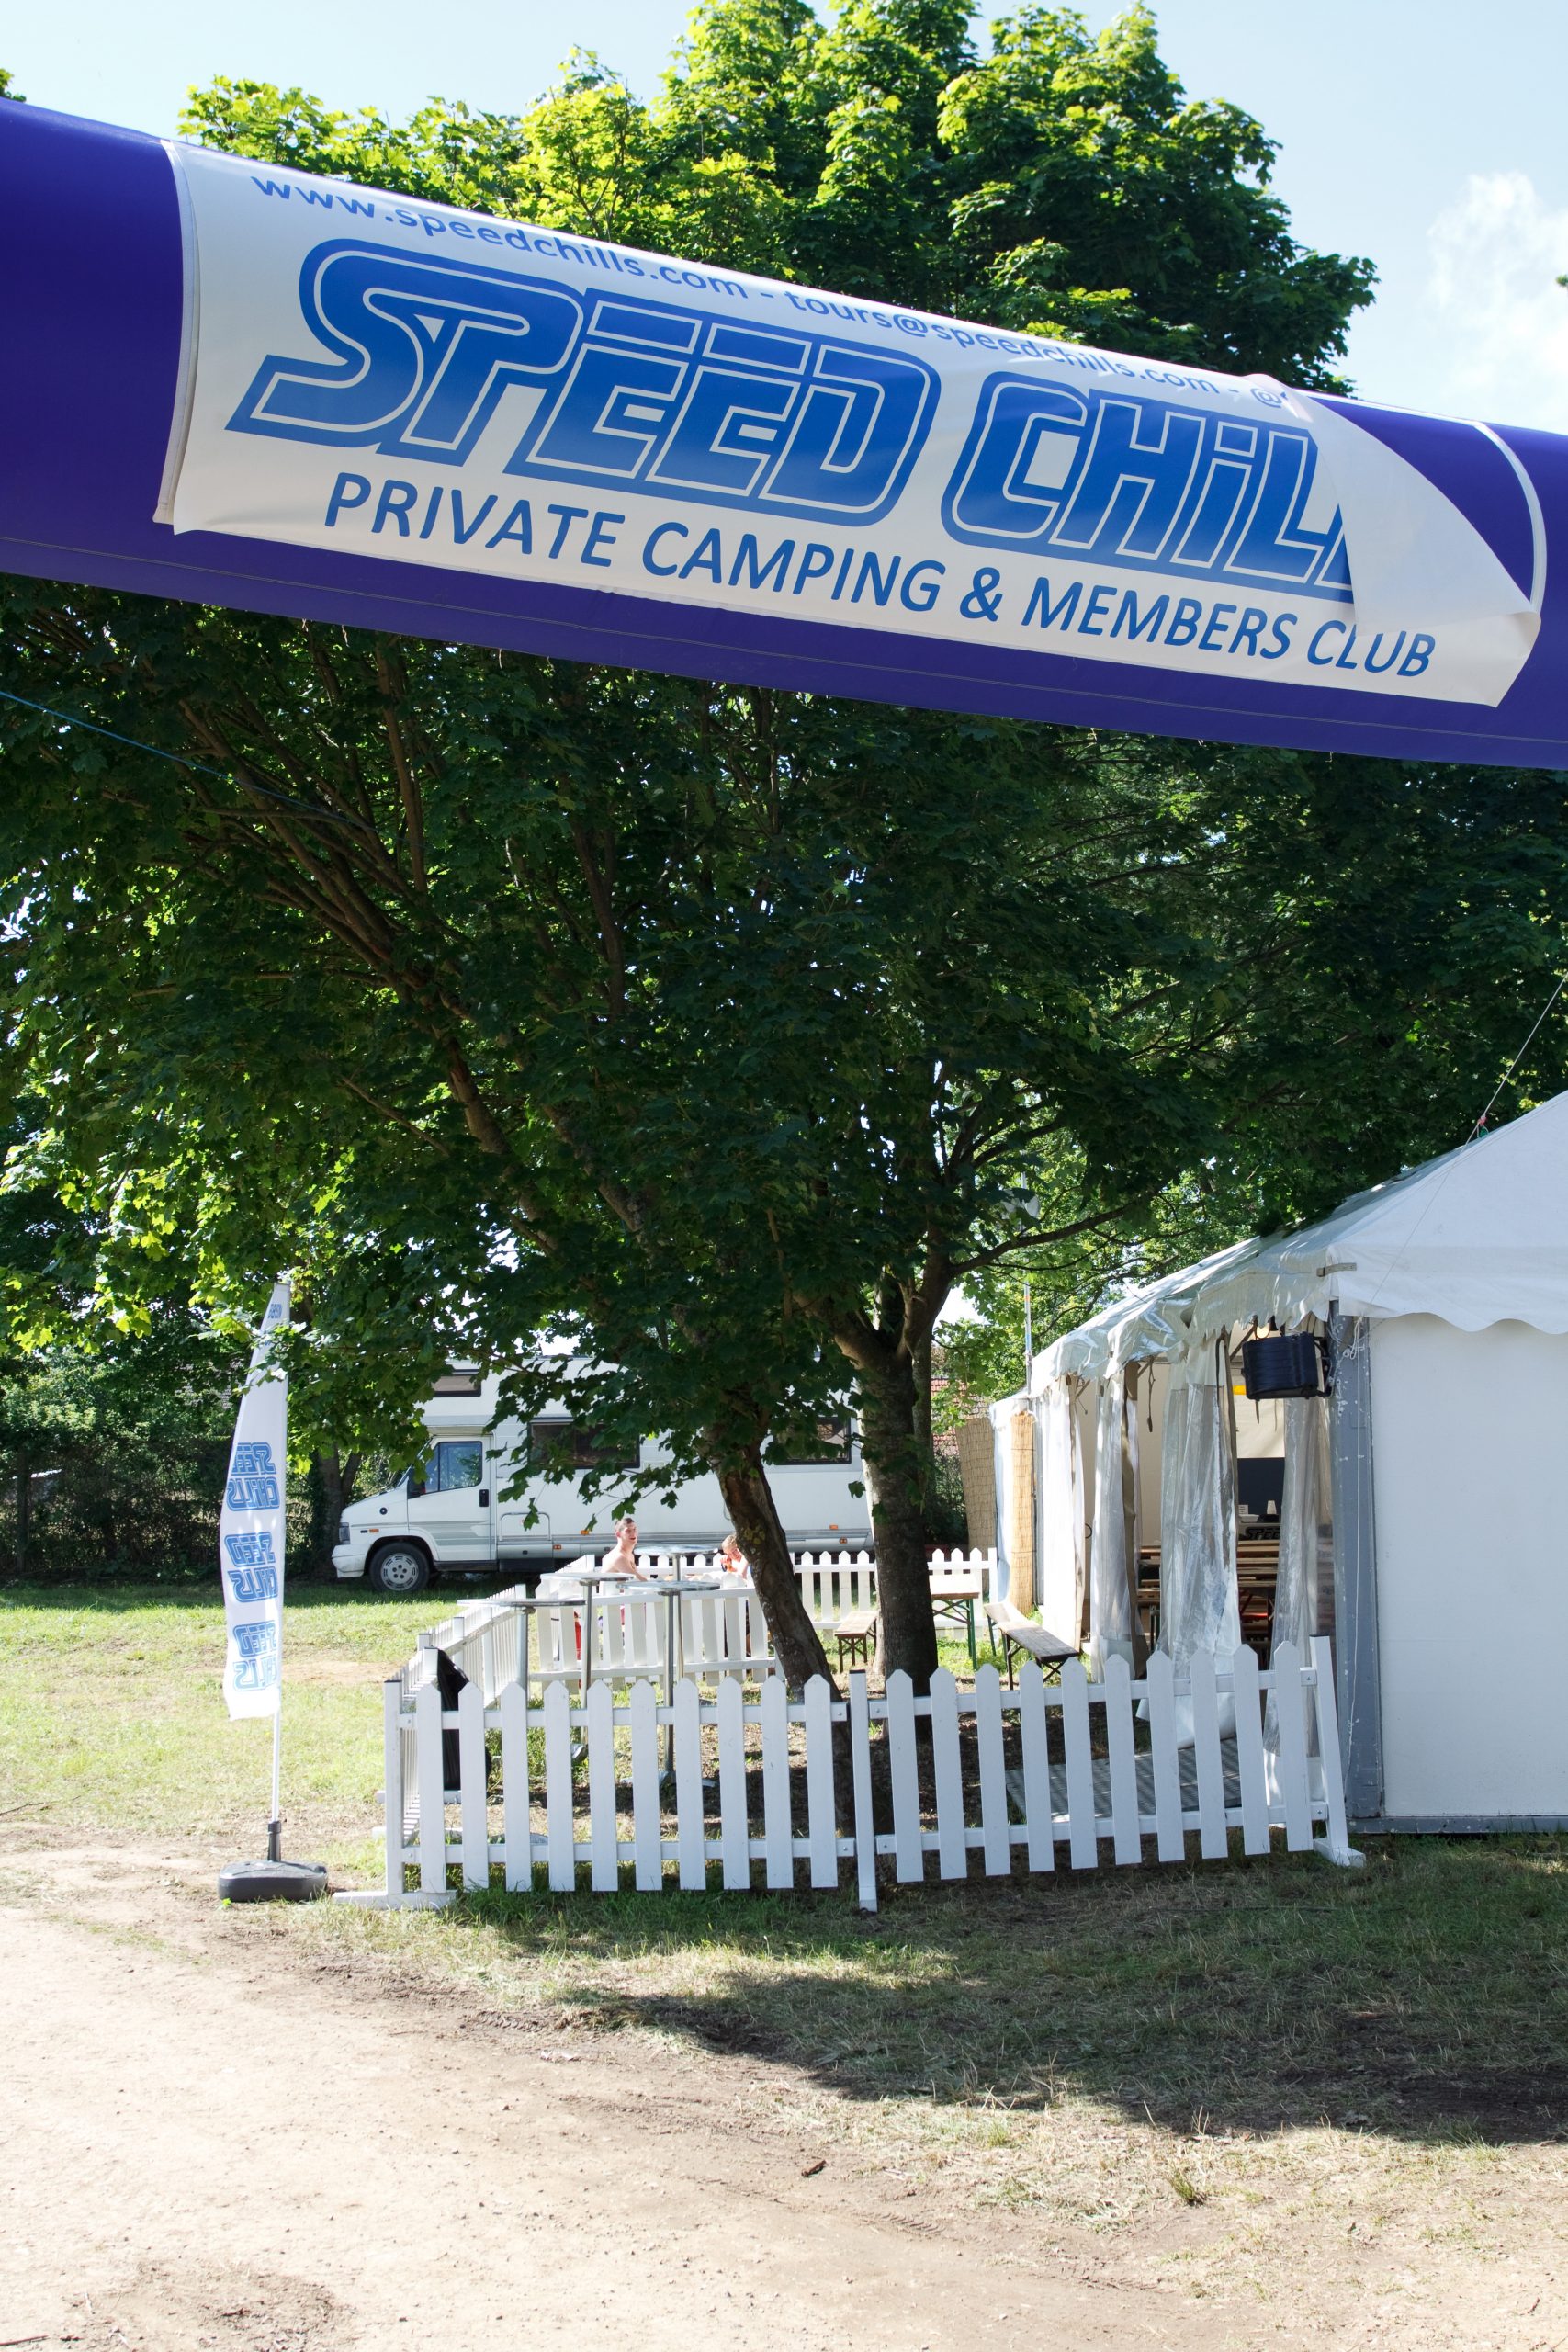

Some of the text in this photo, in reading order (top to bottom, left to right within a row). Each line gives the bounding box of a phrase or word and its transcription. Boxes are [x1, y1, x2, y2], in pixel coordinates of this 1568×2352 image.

[224, 238, 942, 526] SPEED
[251, 176, 748, 299] www.speedchills.com
[784, 290, 1220, 394] tours@speedchills.com
[324, 472, 1436, 677] PRIVATE CAMPING & MEMBERS CLUB
